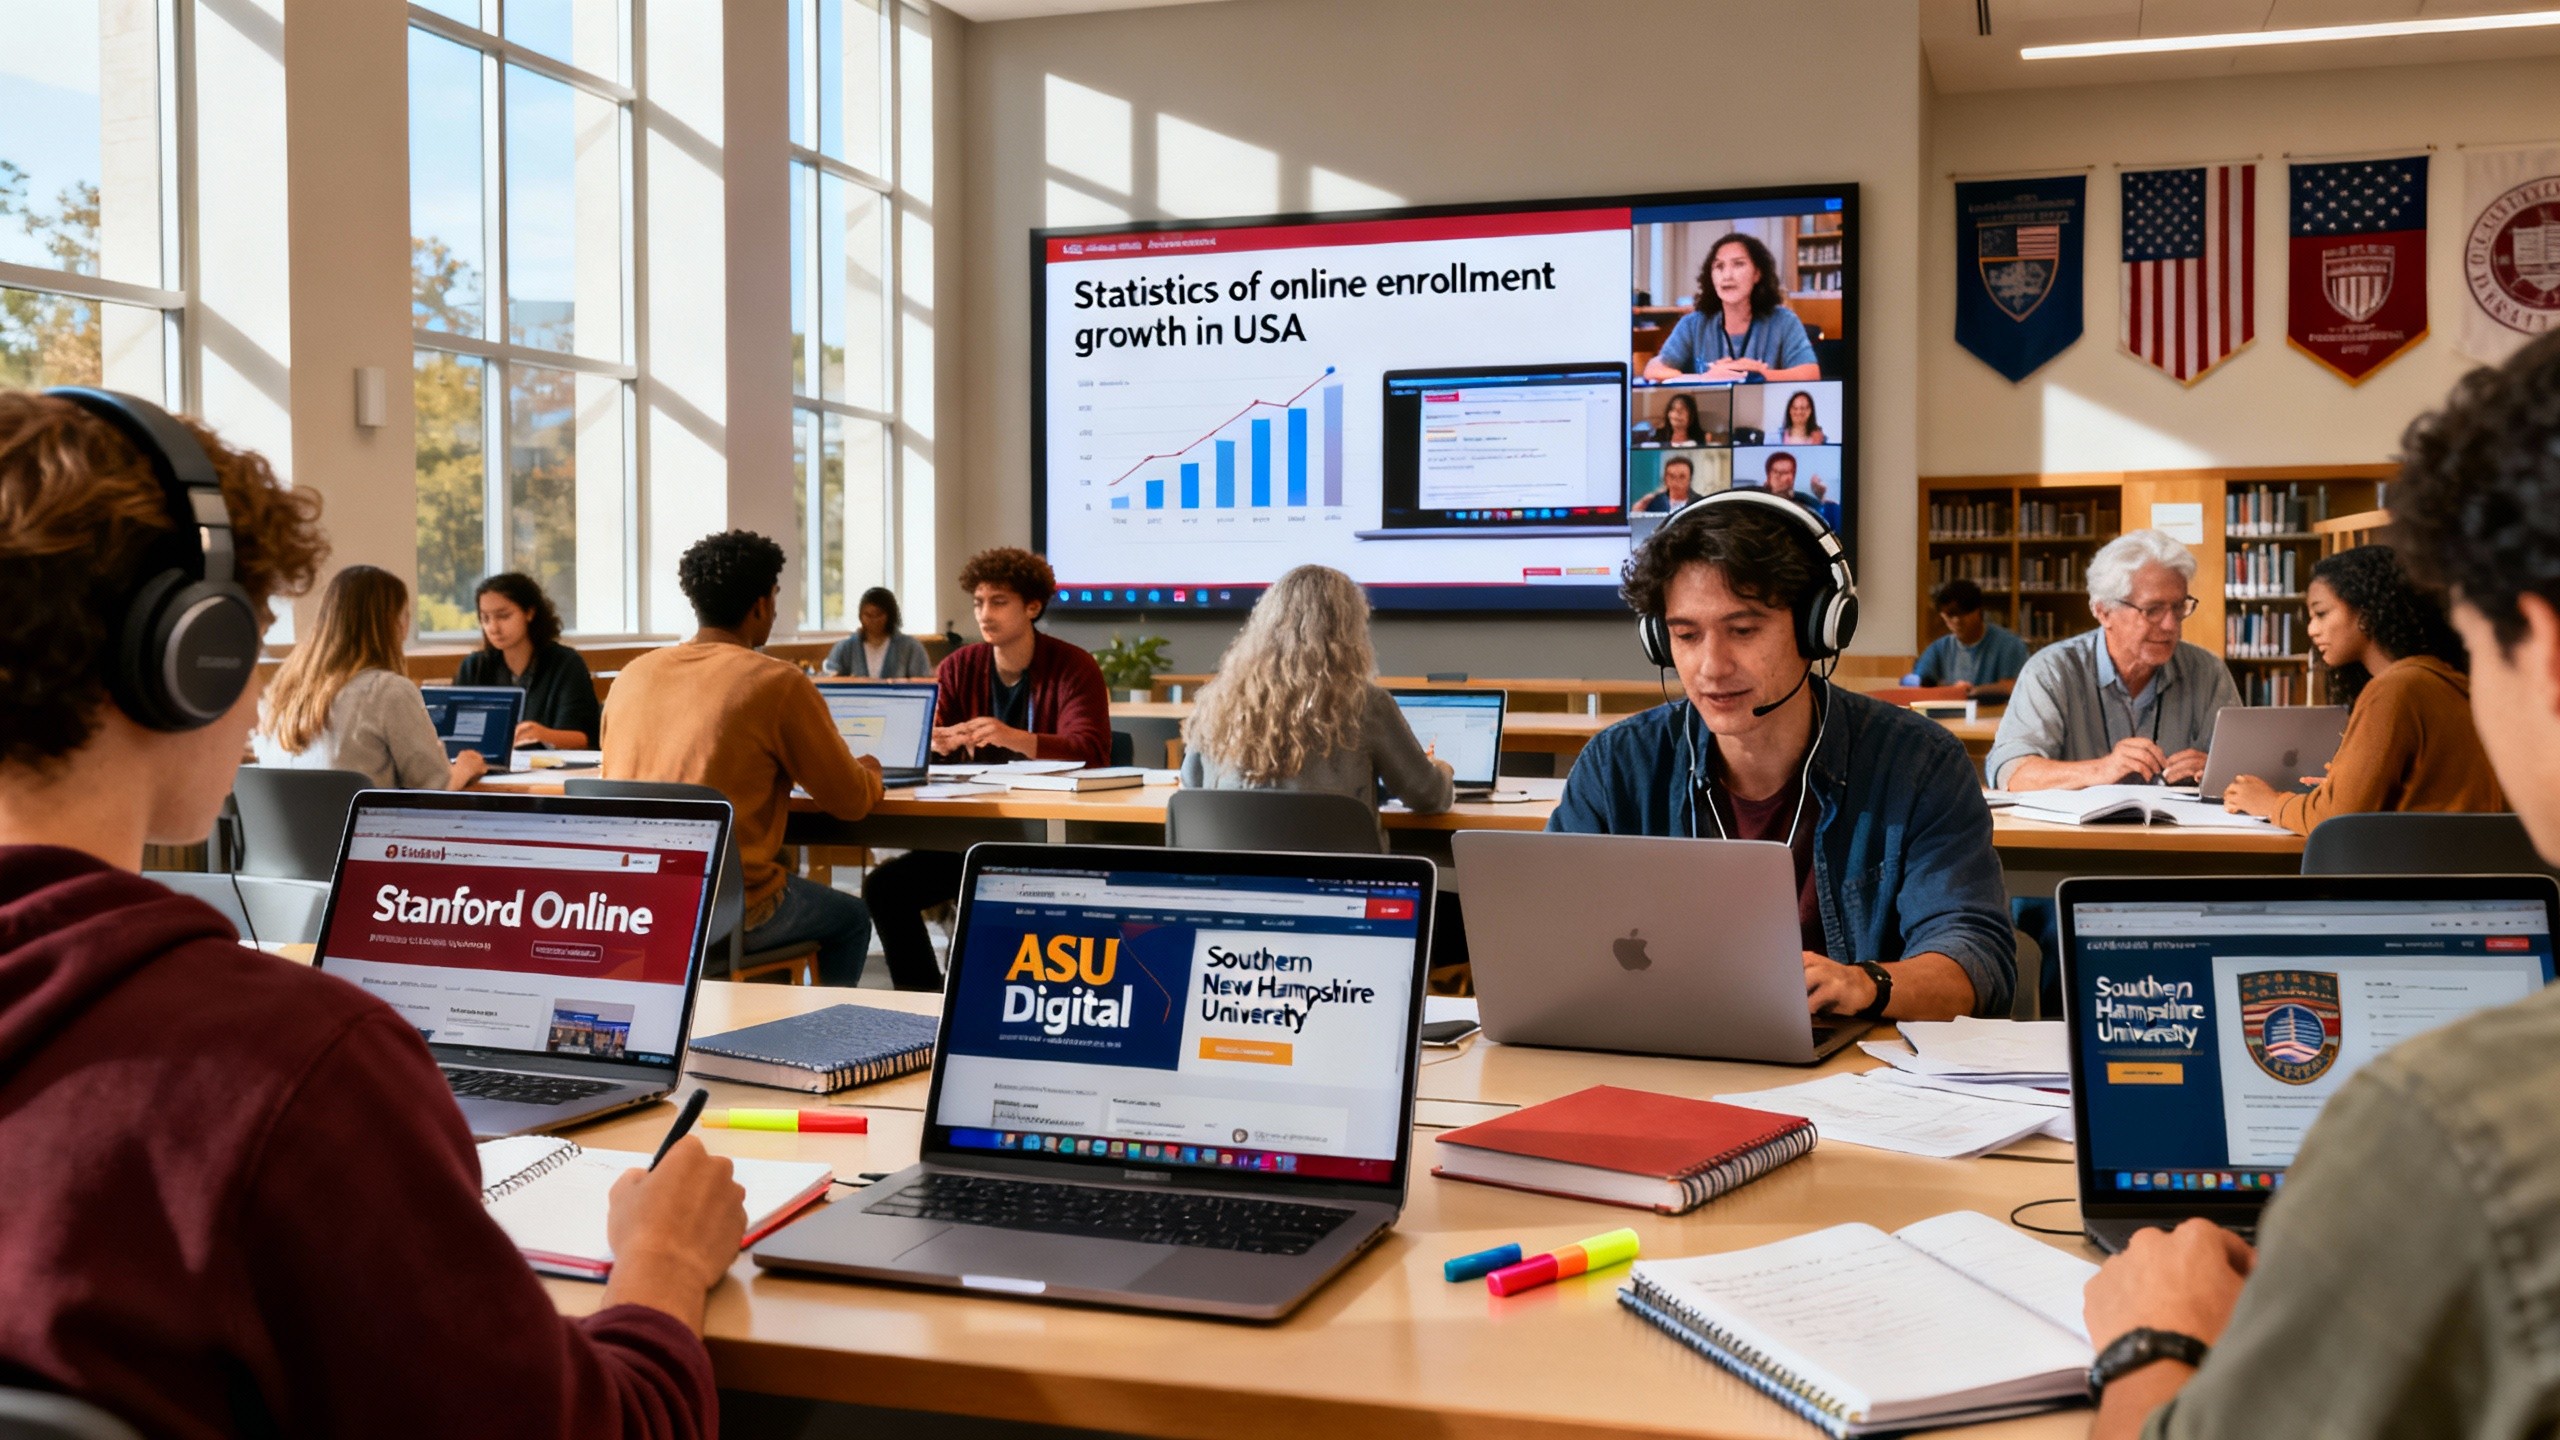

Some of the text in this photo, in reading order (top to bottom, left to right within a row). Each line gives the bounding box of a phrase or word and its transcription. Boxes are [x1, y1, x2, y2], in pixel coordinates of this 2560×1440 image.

[1074, 261, 1556, 310] Statistics of online enrollment
[1075, 313, 1307, 357] growth in USA
[373, 884, 653, 936] Stanford Online
[1005, 932, 1120, 986] ASU
[1207, 945, 1313, 973] Southern
[1202, 973, 1253, 997] New
[1002, 984, 1133, 1036] Digital
